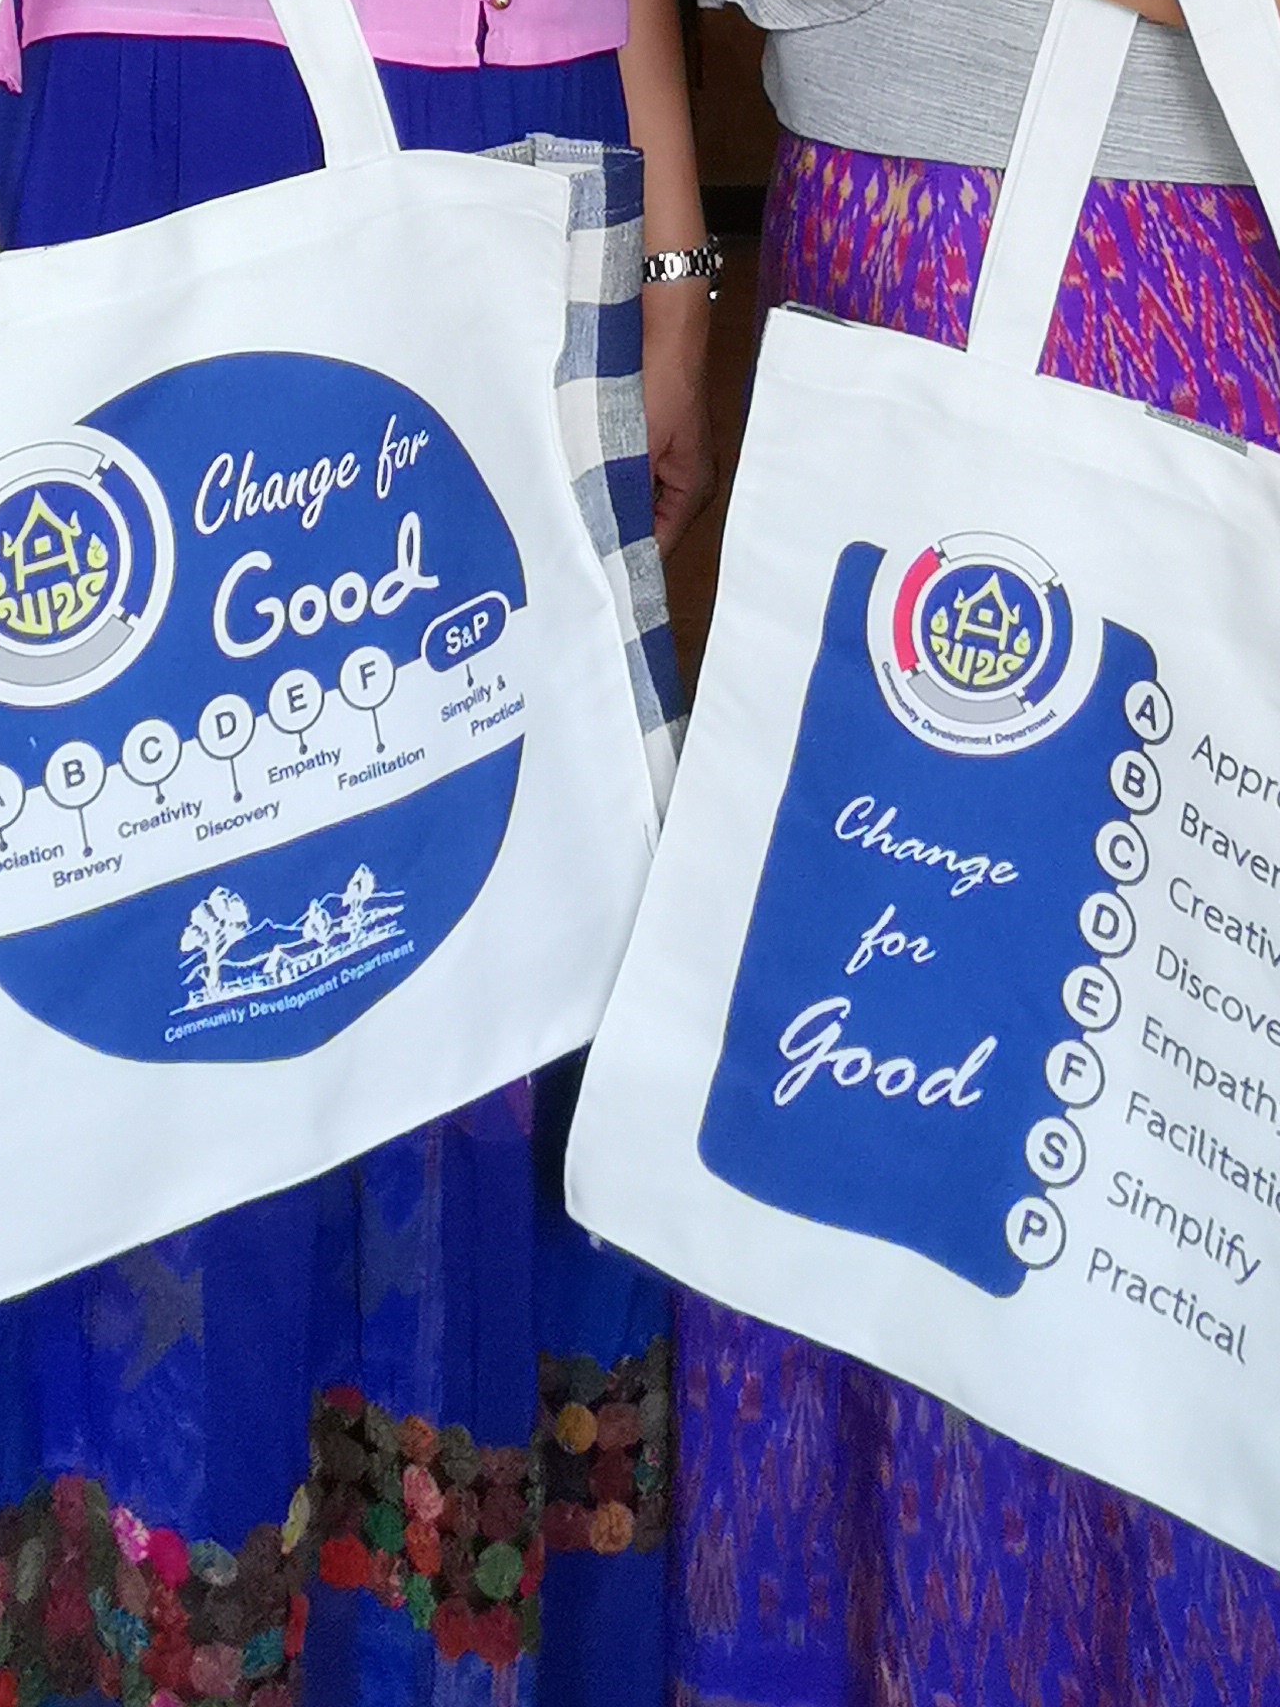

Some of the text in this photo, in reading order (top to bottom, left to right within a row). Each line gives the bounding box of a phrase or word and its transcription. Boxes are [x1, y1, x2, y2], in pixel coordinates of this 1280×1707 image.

[194, 414, 429, 535] Change for
[213, 512, 440, 658] Good
[62, 759, 85, 789] B
[139, 736, 162, 764] C
[215, 711, 237, 740] D
[286, 683, 307, 713] E
[359, 661, 376, 690] F
[446, 611, 489, 655] S&P
[441, 685, 491, 722] Simplify
[470, 693, 525, 737] Practical
[882, 661, 1057, 745] Community Development Department
[1135, 694, 1157, 731] A
[267, 748, 342, 785] Empathy
[337, 747, 425, 790] Facilitation
[1123, 761, 1146, 798] B
[118, 799, 202, 839] Creativity
[195, 800, 280, 842] Discovery
[834, 795, 1019, 897] Change
[1109, 834, 1135, 870] C
[52, 854, 123, 888] Bravery
[844, 903, 937, 976] for
[1092, 903, 1120, 940] D
[164, 939, 414, 1043] Community Development Department
[1077, 977, 1104, 1018] E
[773, 996, 999, 1107] Good
[1059, 1052, 1087, 1087] F
[1039, 1132, 1261, 1285] S Simplify
[1019, 1210, 1246, 1365] P Practical
